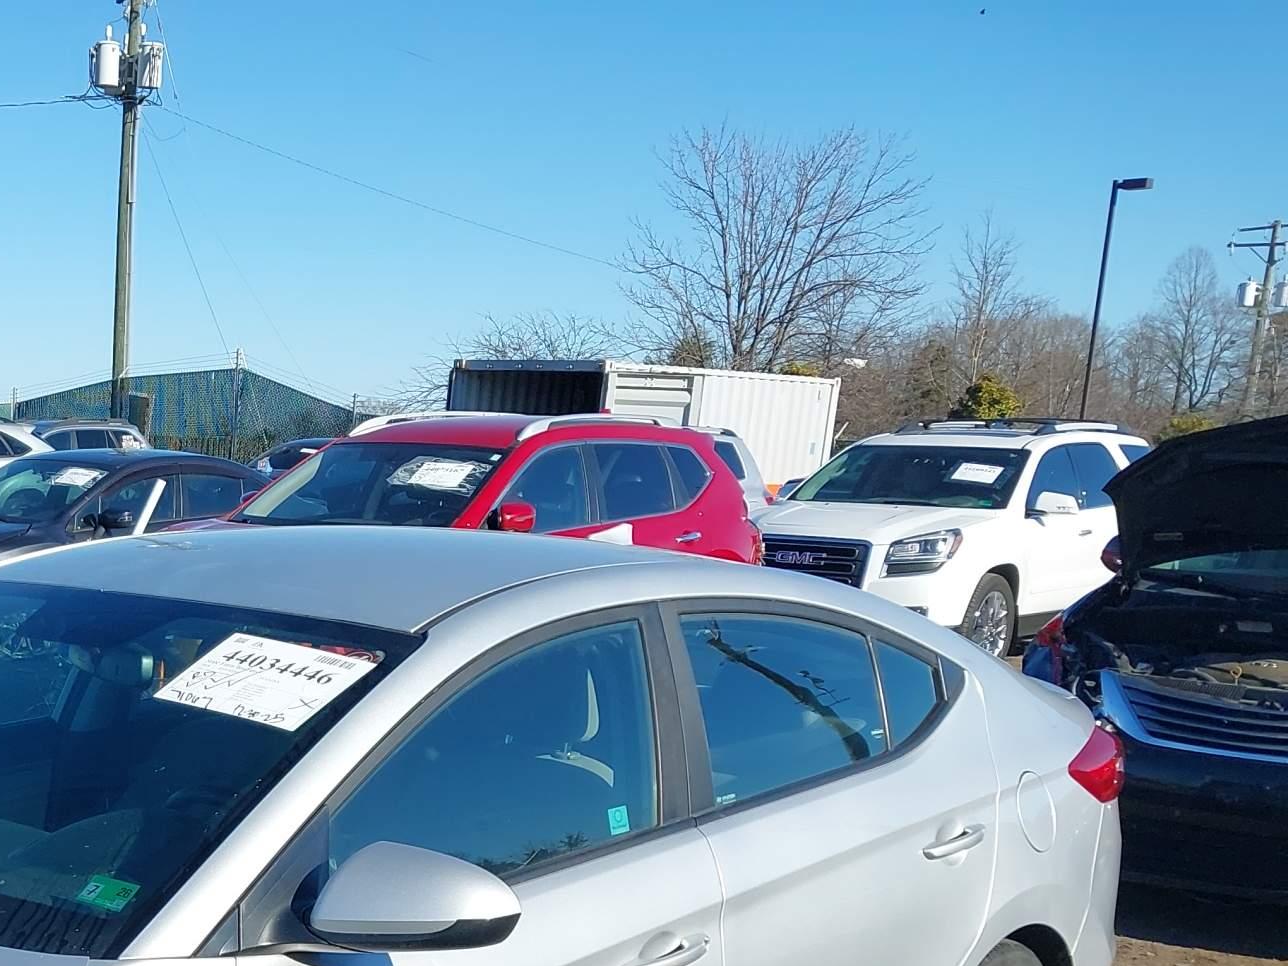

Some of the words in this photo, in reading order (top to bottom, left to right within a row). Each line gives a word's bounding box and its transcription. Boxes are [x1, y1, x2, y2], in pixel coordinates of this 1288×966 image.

[776, 551, 827, 565] GMC
[222, 649, 333, 685] 44034446
[116, 887, 133, 899] 26
